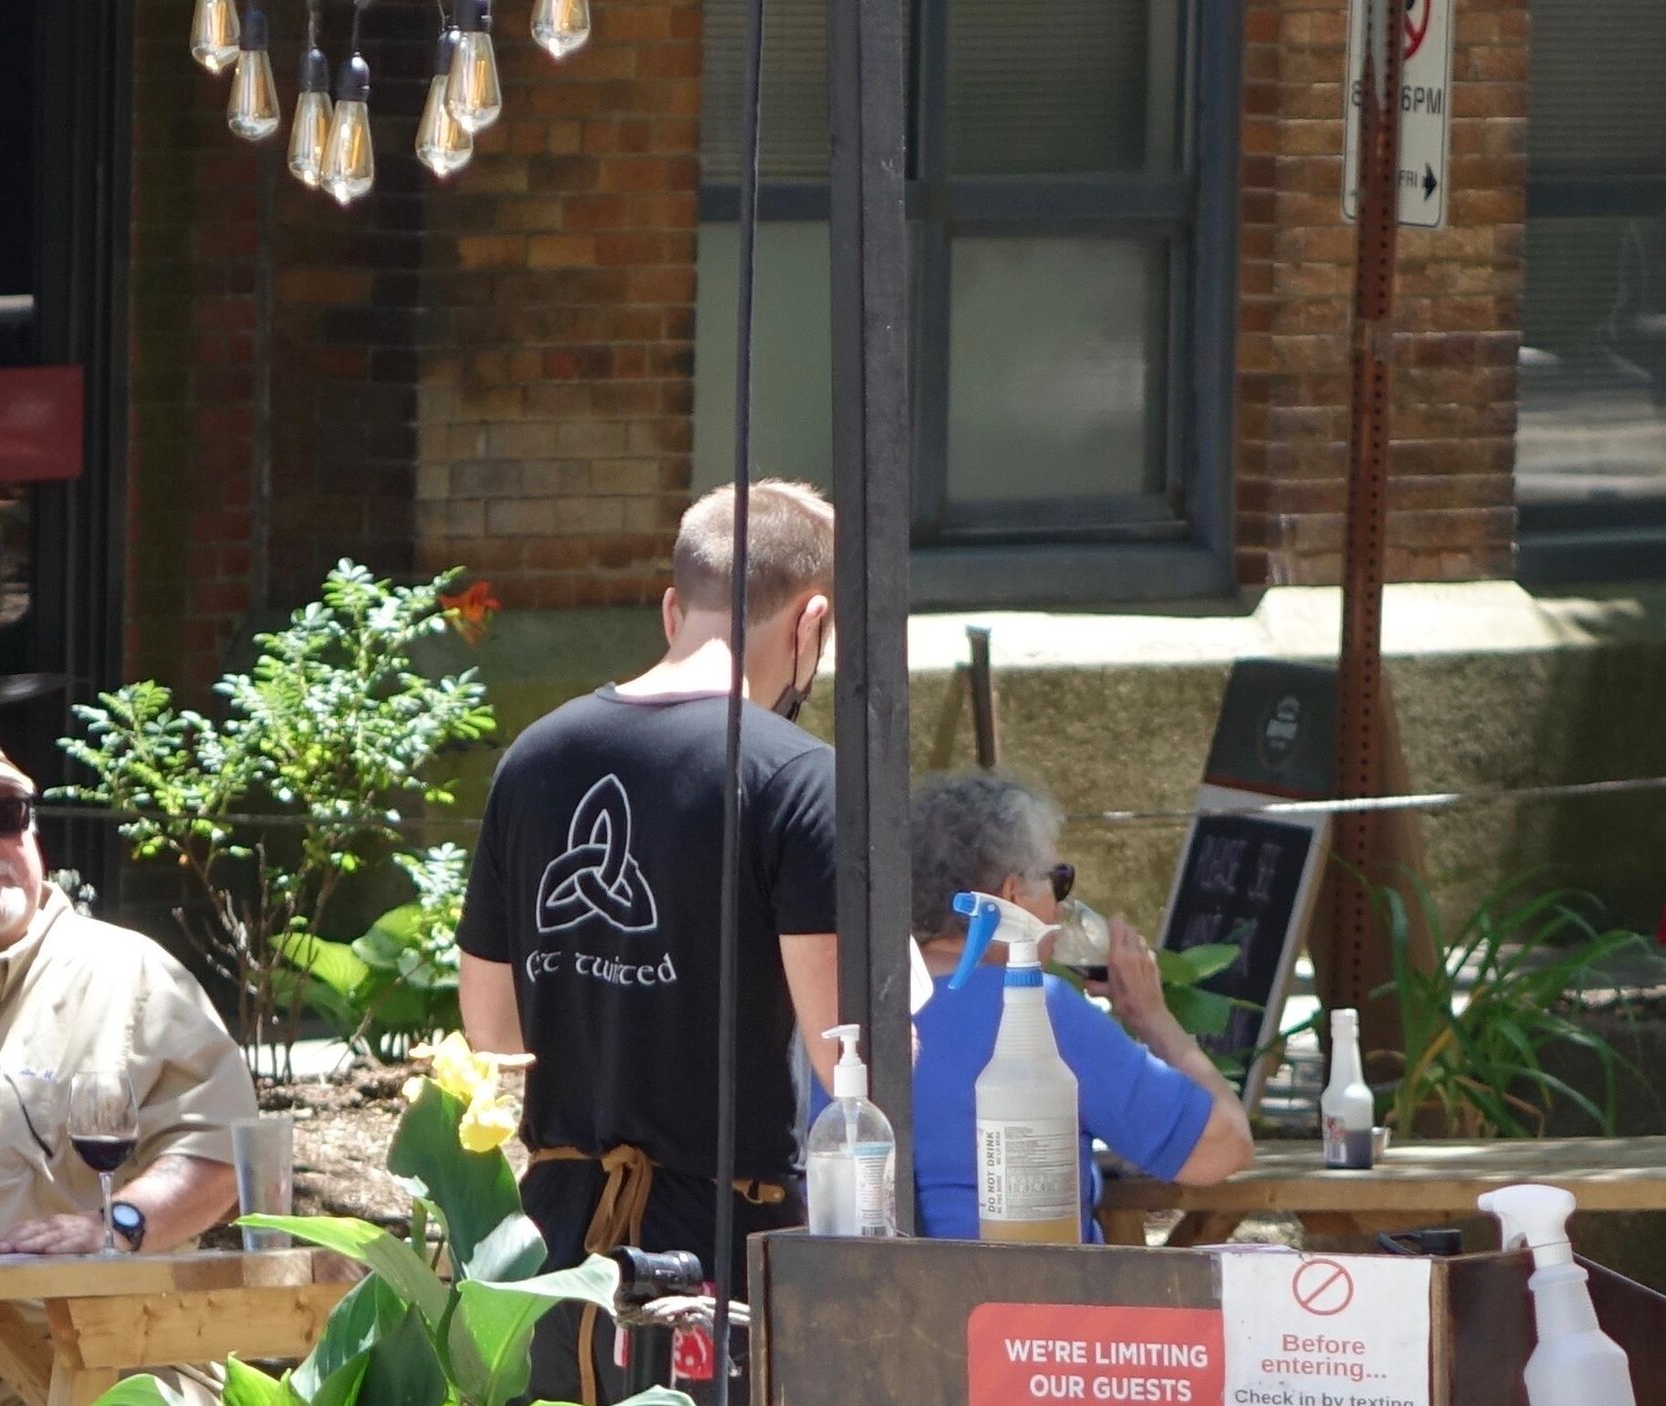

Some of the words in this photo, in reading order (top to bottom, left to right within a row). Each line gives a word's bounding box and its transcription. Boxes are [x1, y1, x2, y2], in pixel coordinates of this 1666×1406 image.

[1400, 84, 1441, 114] 6PM
[985, 1131, 995, 1167] DRINK
[987, 1171, 996, 1194] NOT
[987, 1196, 996, 1213] DO
[1004, 1338, 1087, 1364] WE'RE
[1095, 1342, 1208, 1368] LIMITING
[1282, 1334, 1366, 1355] Before
[1261, 1357, 1387, 1383] entering...
[1029, 1374, 1085, 1399] OUR
[1092, 1376, 1192, 1402] GUESTS
[1235, 1389, 1294, 1406] Check
[1299, 1391, 1316, 1406] in
